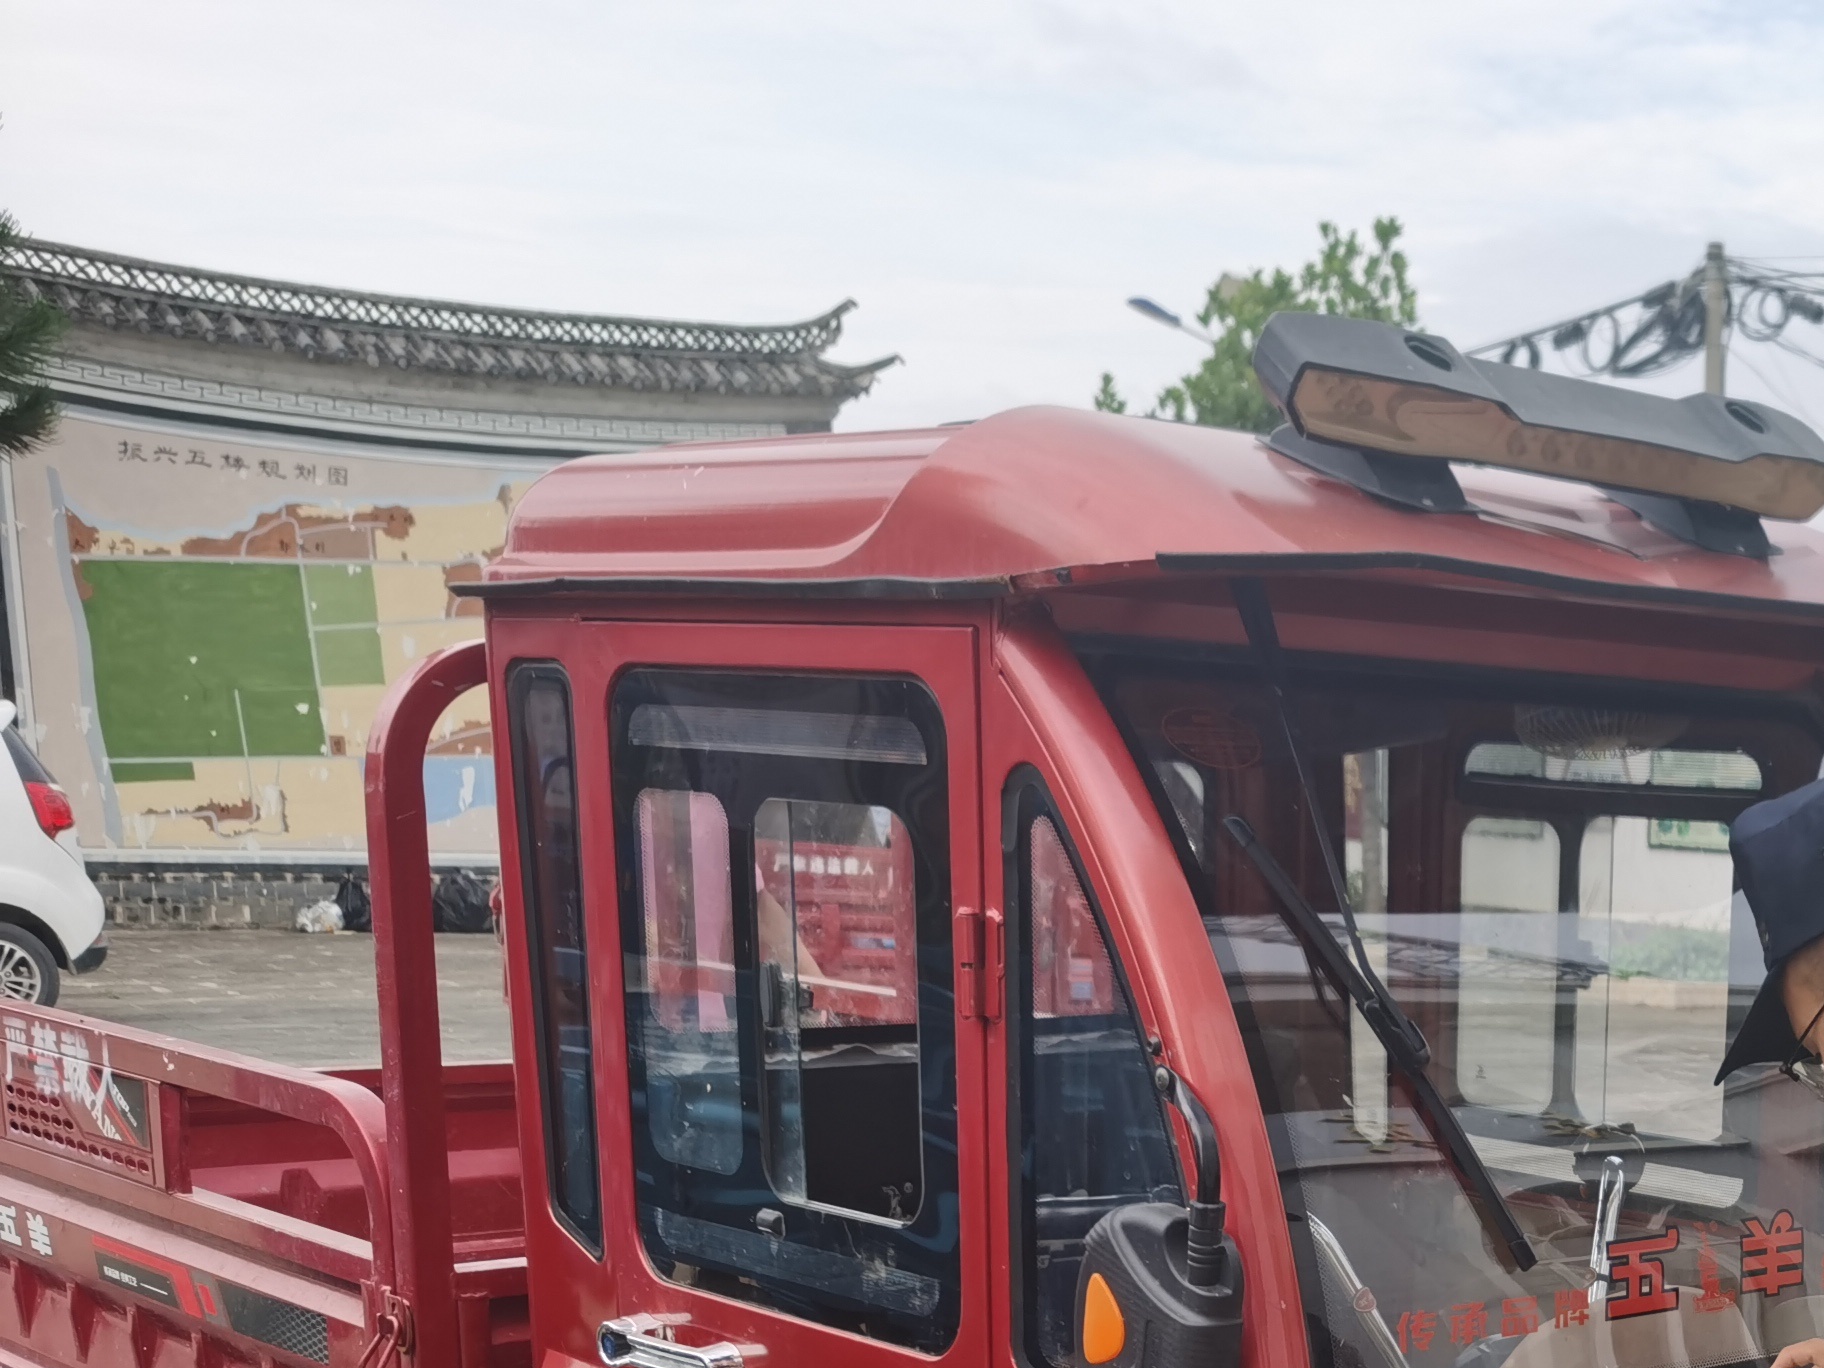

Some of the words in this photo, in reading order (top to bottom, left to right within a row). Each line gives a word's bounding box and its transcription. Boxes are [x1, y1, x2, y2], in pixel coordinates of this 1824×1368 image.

[0, 1204, 53, 1256] 五羊
[1396, 1289, 1590, 1353] 传承品牌
